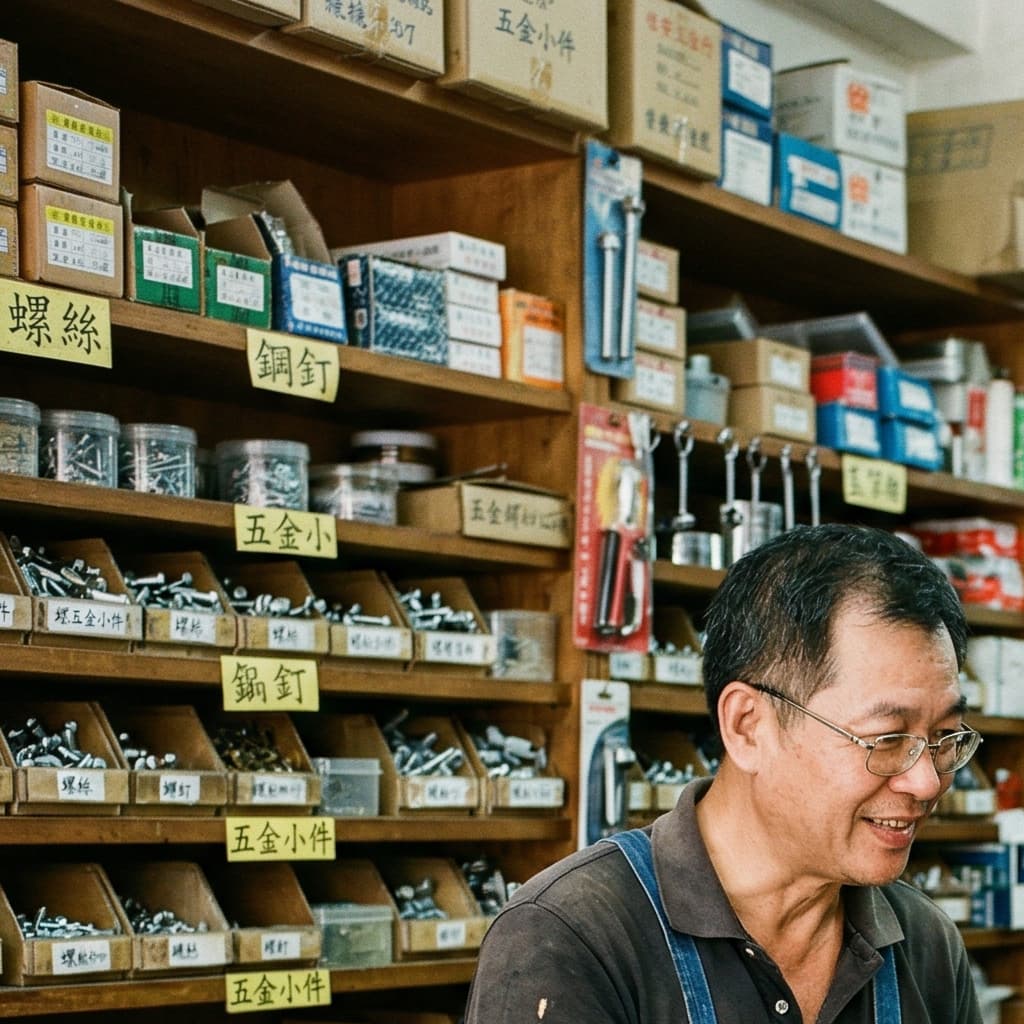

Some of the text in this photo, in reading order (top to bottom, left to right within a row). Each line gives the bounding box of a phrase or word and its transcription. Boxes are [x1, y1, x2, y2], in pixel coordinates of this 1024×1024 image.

[496, 8, 575, 63] 五金小件
[8, 292, 101, 355] 螺絲
[243, 512, 332, 551] 五金小
[231, 821, 332, 855] 五金小件
[231, 971, 326, 1007] 五金小件
